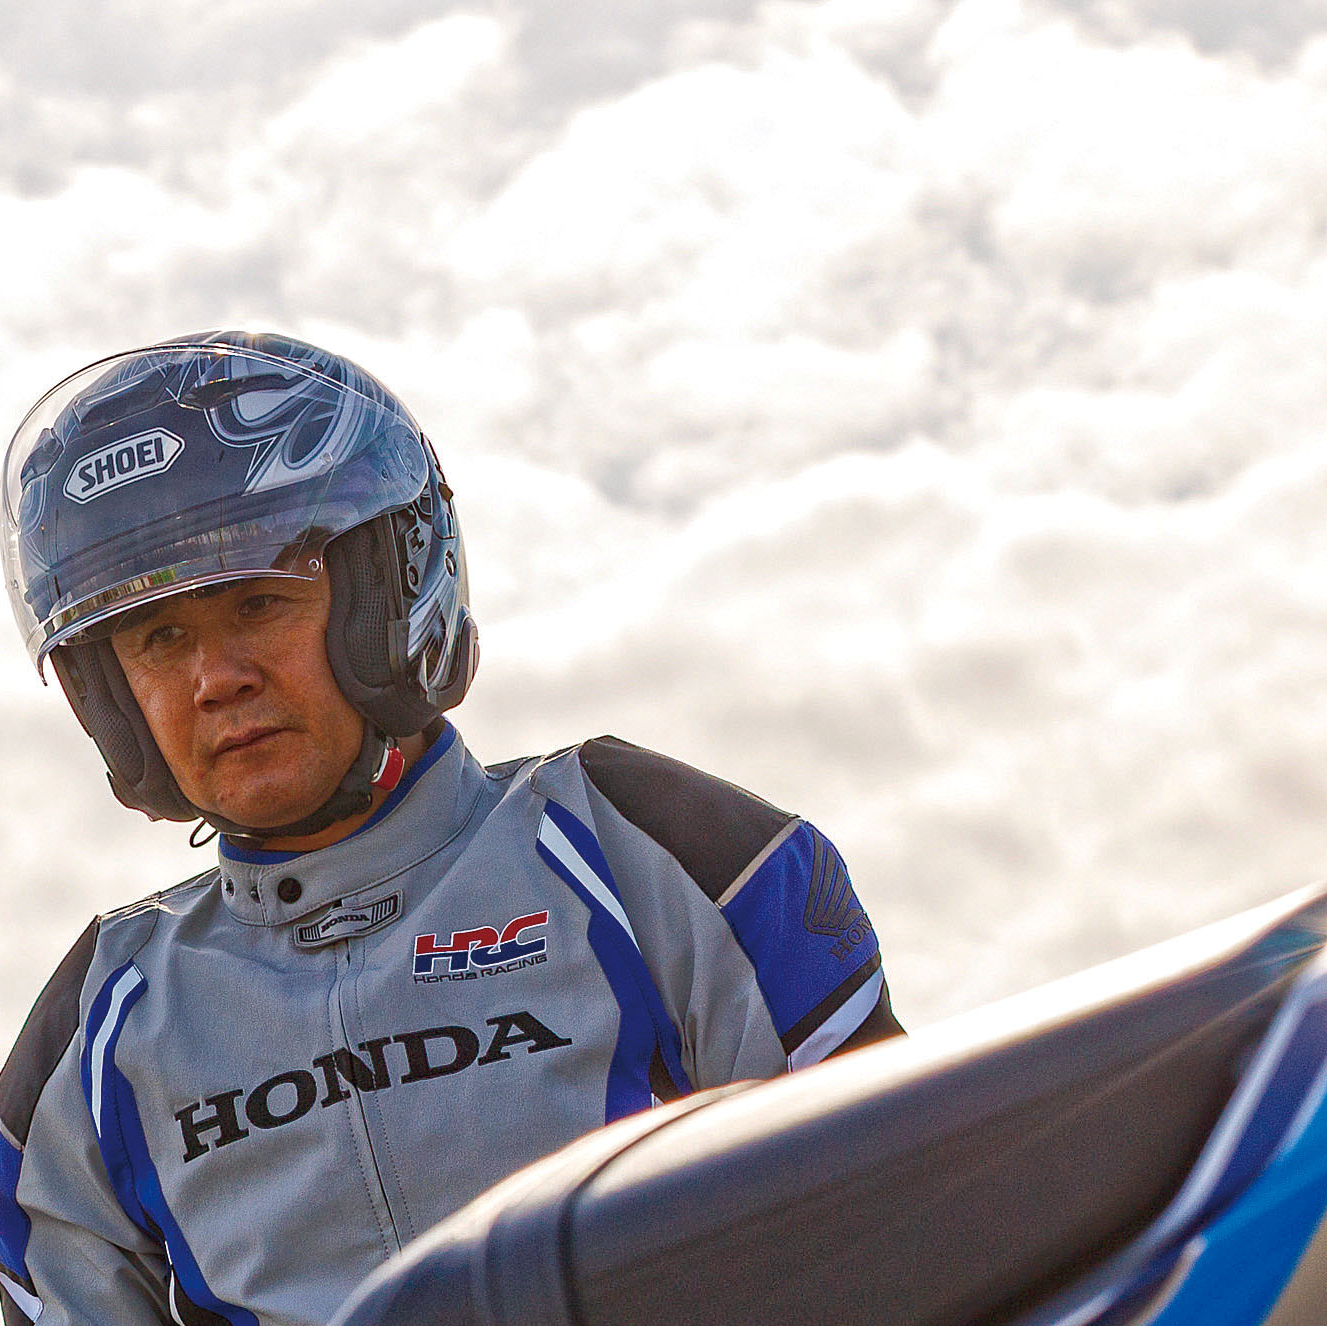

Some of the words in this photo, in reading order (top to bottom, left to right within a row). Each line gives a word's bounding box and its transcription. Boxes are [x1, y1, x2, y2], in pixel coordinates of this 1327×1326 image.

[78, 437, 165, 494] SHOEI
[320, 912, 371, 934] HONDA
[413, 910, 549, 975] HRC
[829, 916, 872, 962] HON
[413, 971, 477, 985] Honda
[480, 954, 548, 978] RACING
[175, 1011, 572, 1163] HONDA
